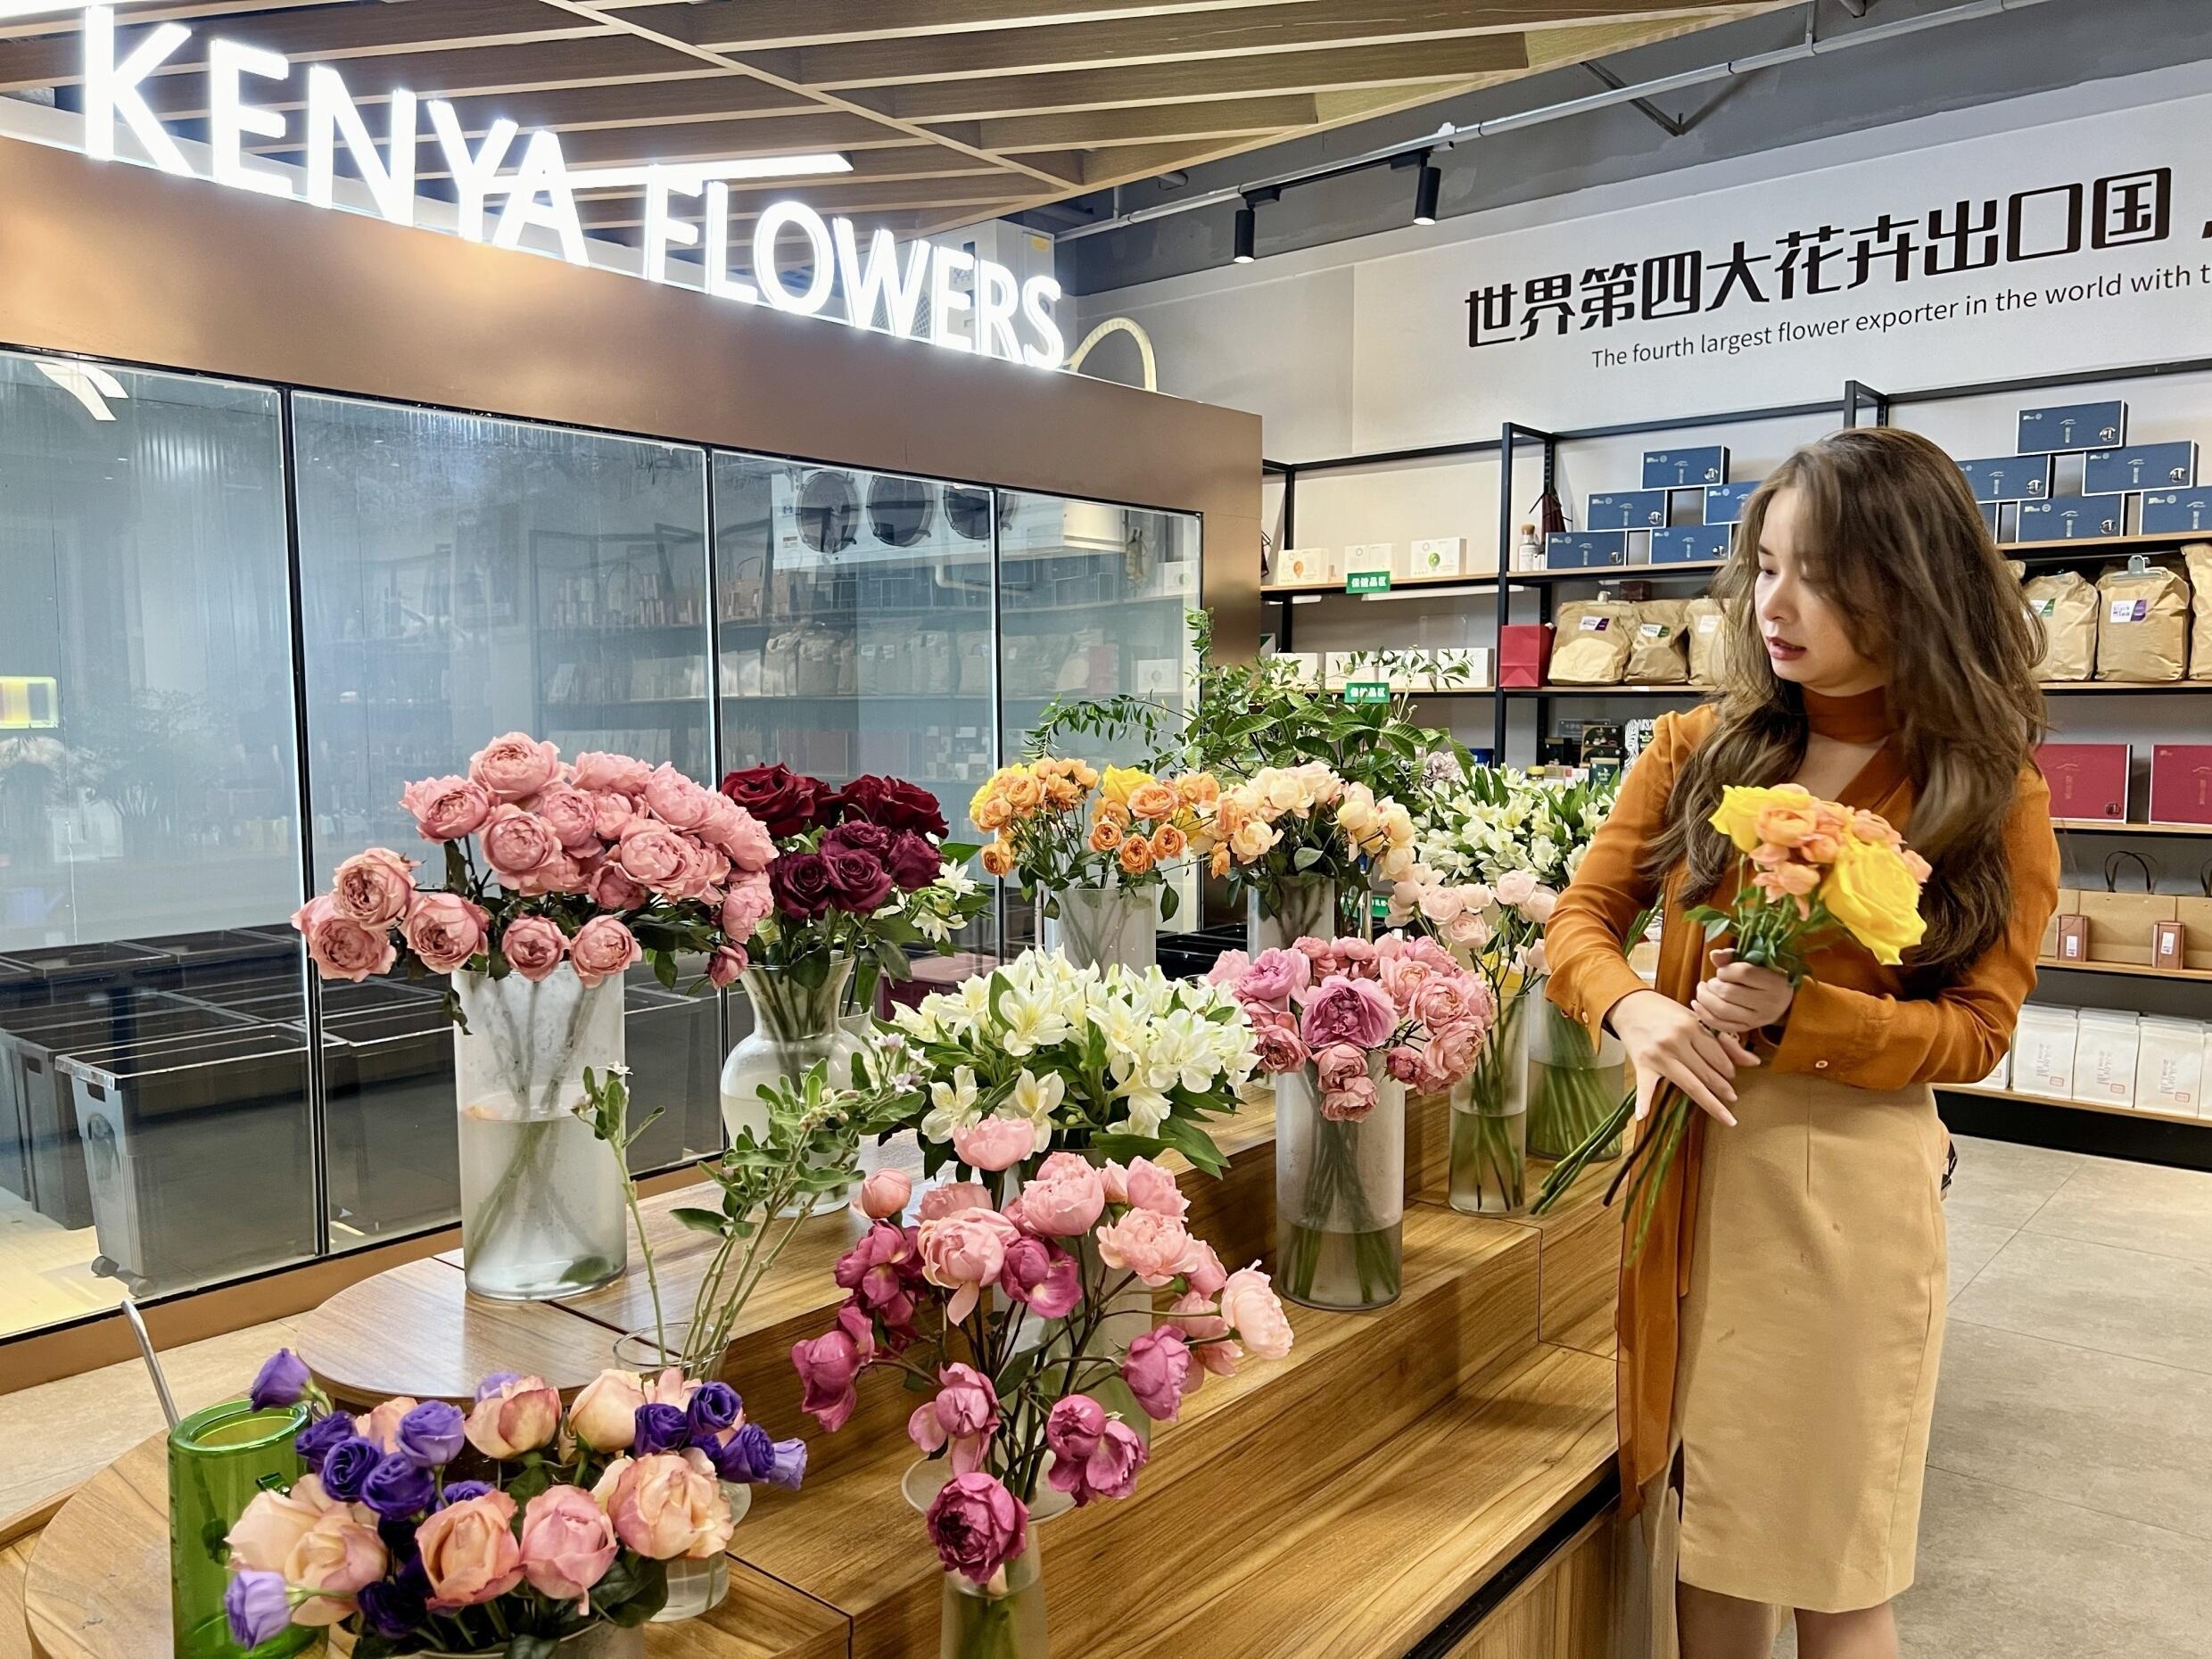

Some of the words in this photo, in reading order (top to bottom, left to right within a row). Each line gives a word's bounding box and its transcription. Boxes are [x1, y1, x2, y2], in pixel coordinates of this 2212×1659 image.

[85, 5, 590, 267] KENYA
[642, 163, 1067, 371] FLOWERS
[1465, 167, 2172, 349] 世界第四大花卉出口国
[1591, 348, 1627, 368] The
[1632, 336, 1694, 363] fourth
[1701, 327, 1772, 355] largest
[1778, 318, 1851, 343] flower
[1855, 302, 1960, 334] exporter
[1966, 295, 1987, 316] in
[1995, 288, 2037, 311] the
[2045, 272, 2122, 304] world
[2130, 264, 2191, 293] with
